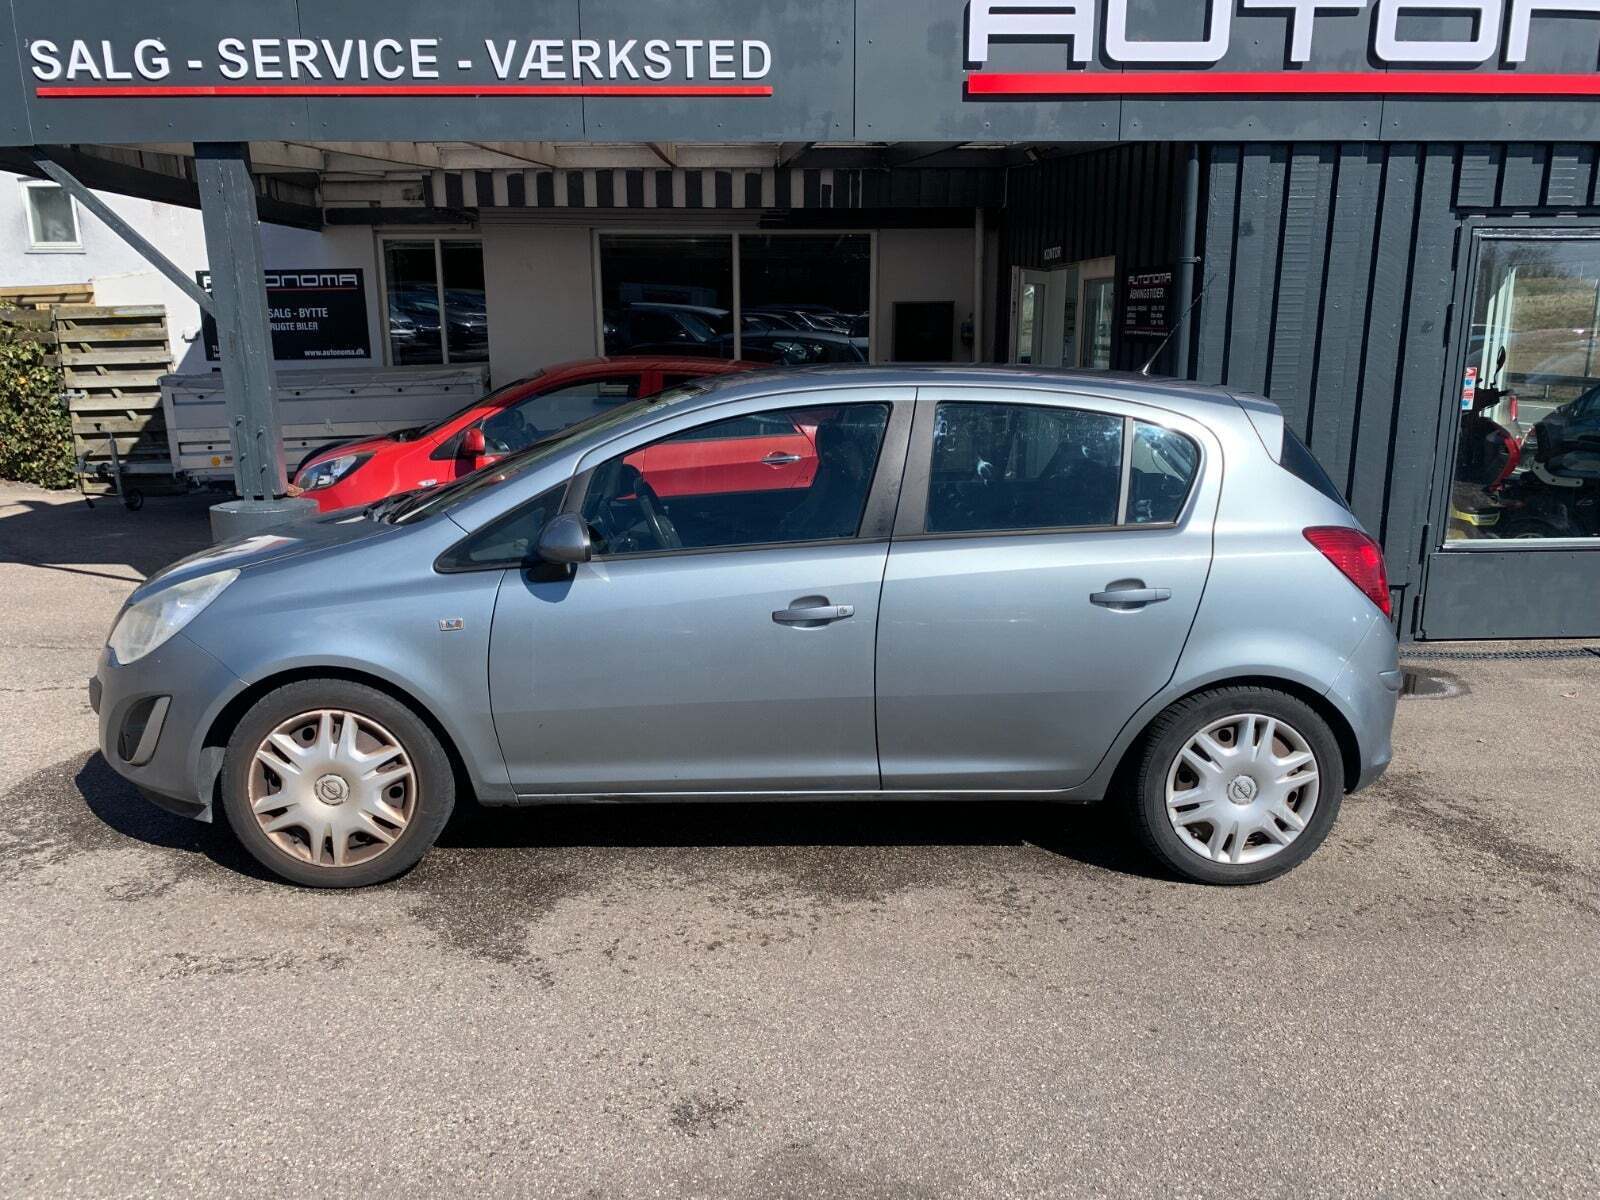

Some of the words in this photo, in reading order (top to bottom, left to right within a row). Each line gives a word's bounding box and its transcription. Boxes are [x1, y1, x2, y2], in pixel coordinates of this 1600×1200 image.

[30, 38, 171, 80] SALG
[187, 59, 202, 69] -
[217, 38, 440, 80] SERVICE
[457, 60, 472, 69] -
[485, 39, 772, 80] VÆRKSTED
[203, 274, 358, 288] ONOMA
[267, 308, 292, 318] SALG
[299, 307, 328, 318] BYTTE
[270, 322, 295, 331] RUGTE
[296, 321, 319, 331] BILER
[304, 348, 365, 357] www.autonoma.dk
